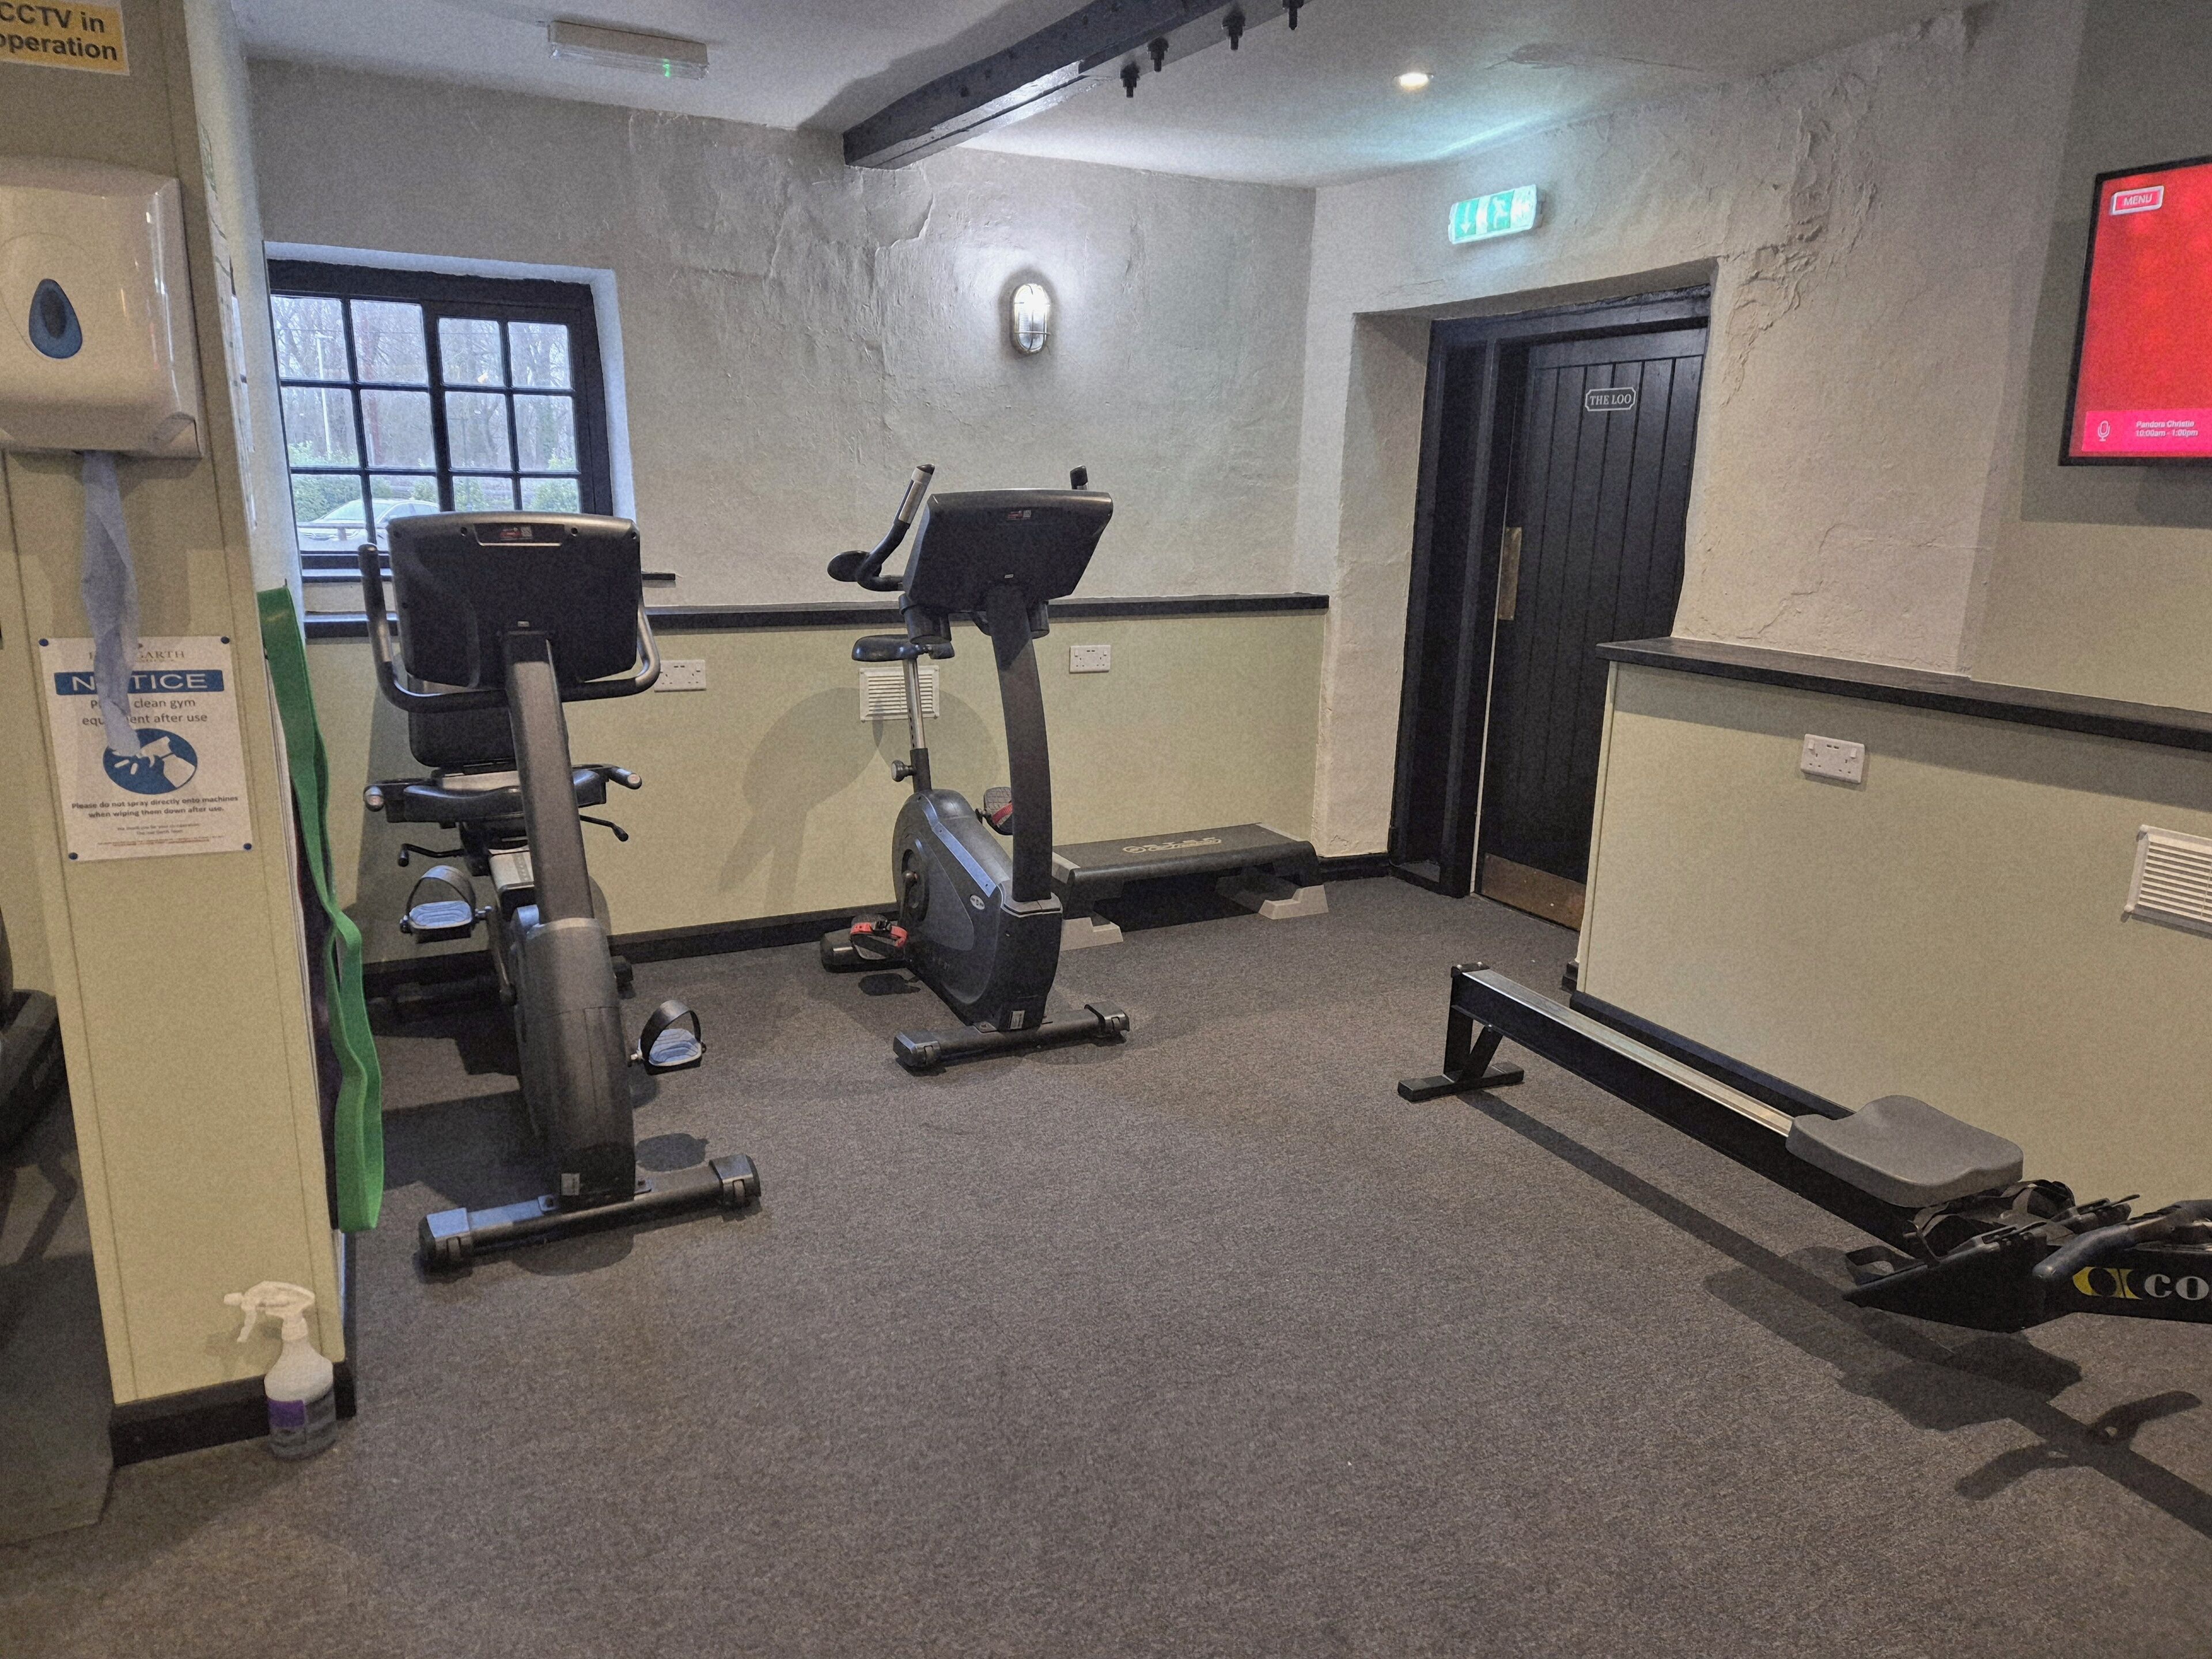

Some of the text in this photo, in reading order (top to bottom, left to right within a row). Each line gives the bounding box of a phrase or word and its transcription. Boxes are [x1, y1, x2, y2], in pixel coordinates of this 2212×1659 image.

[0, 2, 105, 33] CCTV in
[2123, 194, 2153, 206] MENU
[1590, 393, 1632, 406] THE LOO
[71, 673, 208, 691] NTICE
[134, 698, 196, 709] clean gym
[82, 714, 208, 727] equent after use
